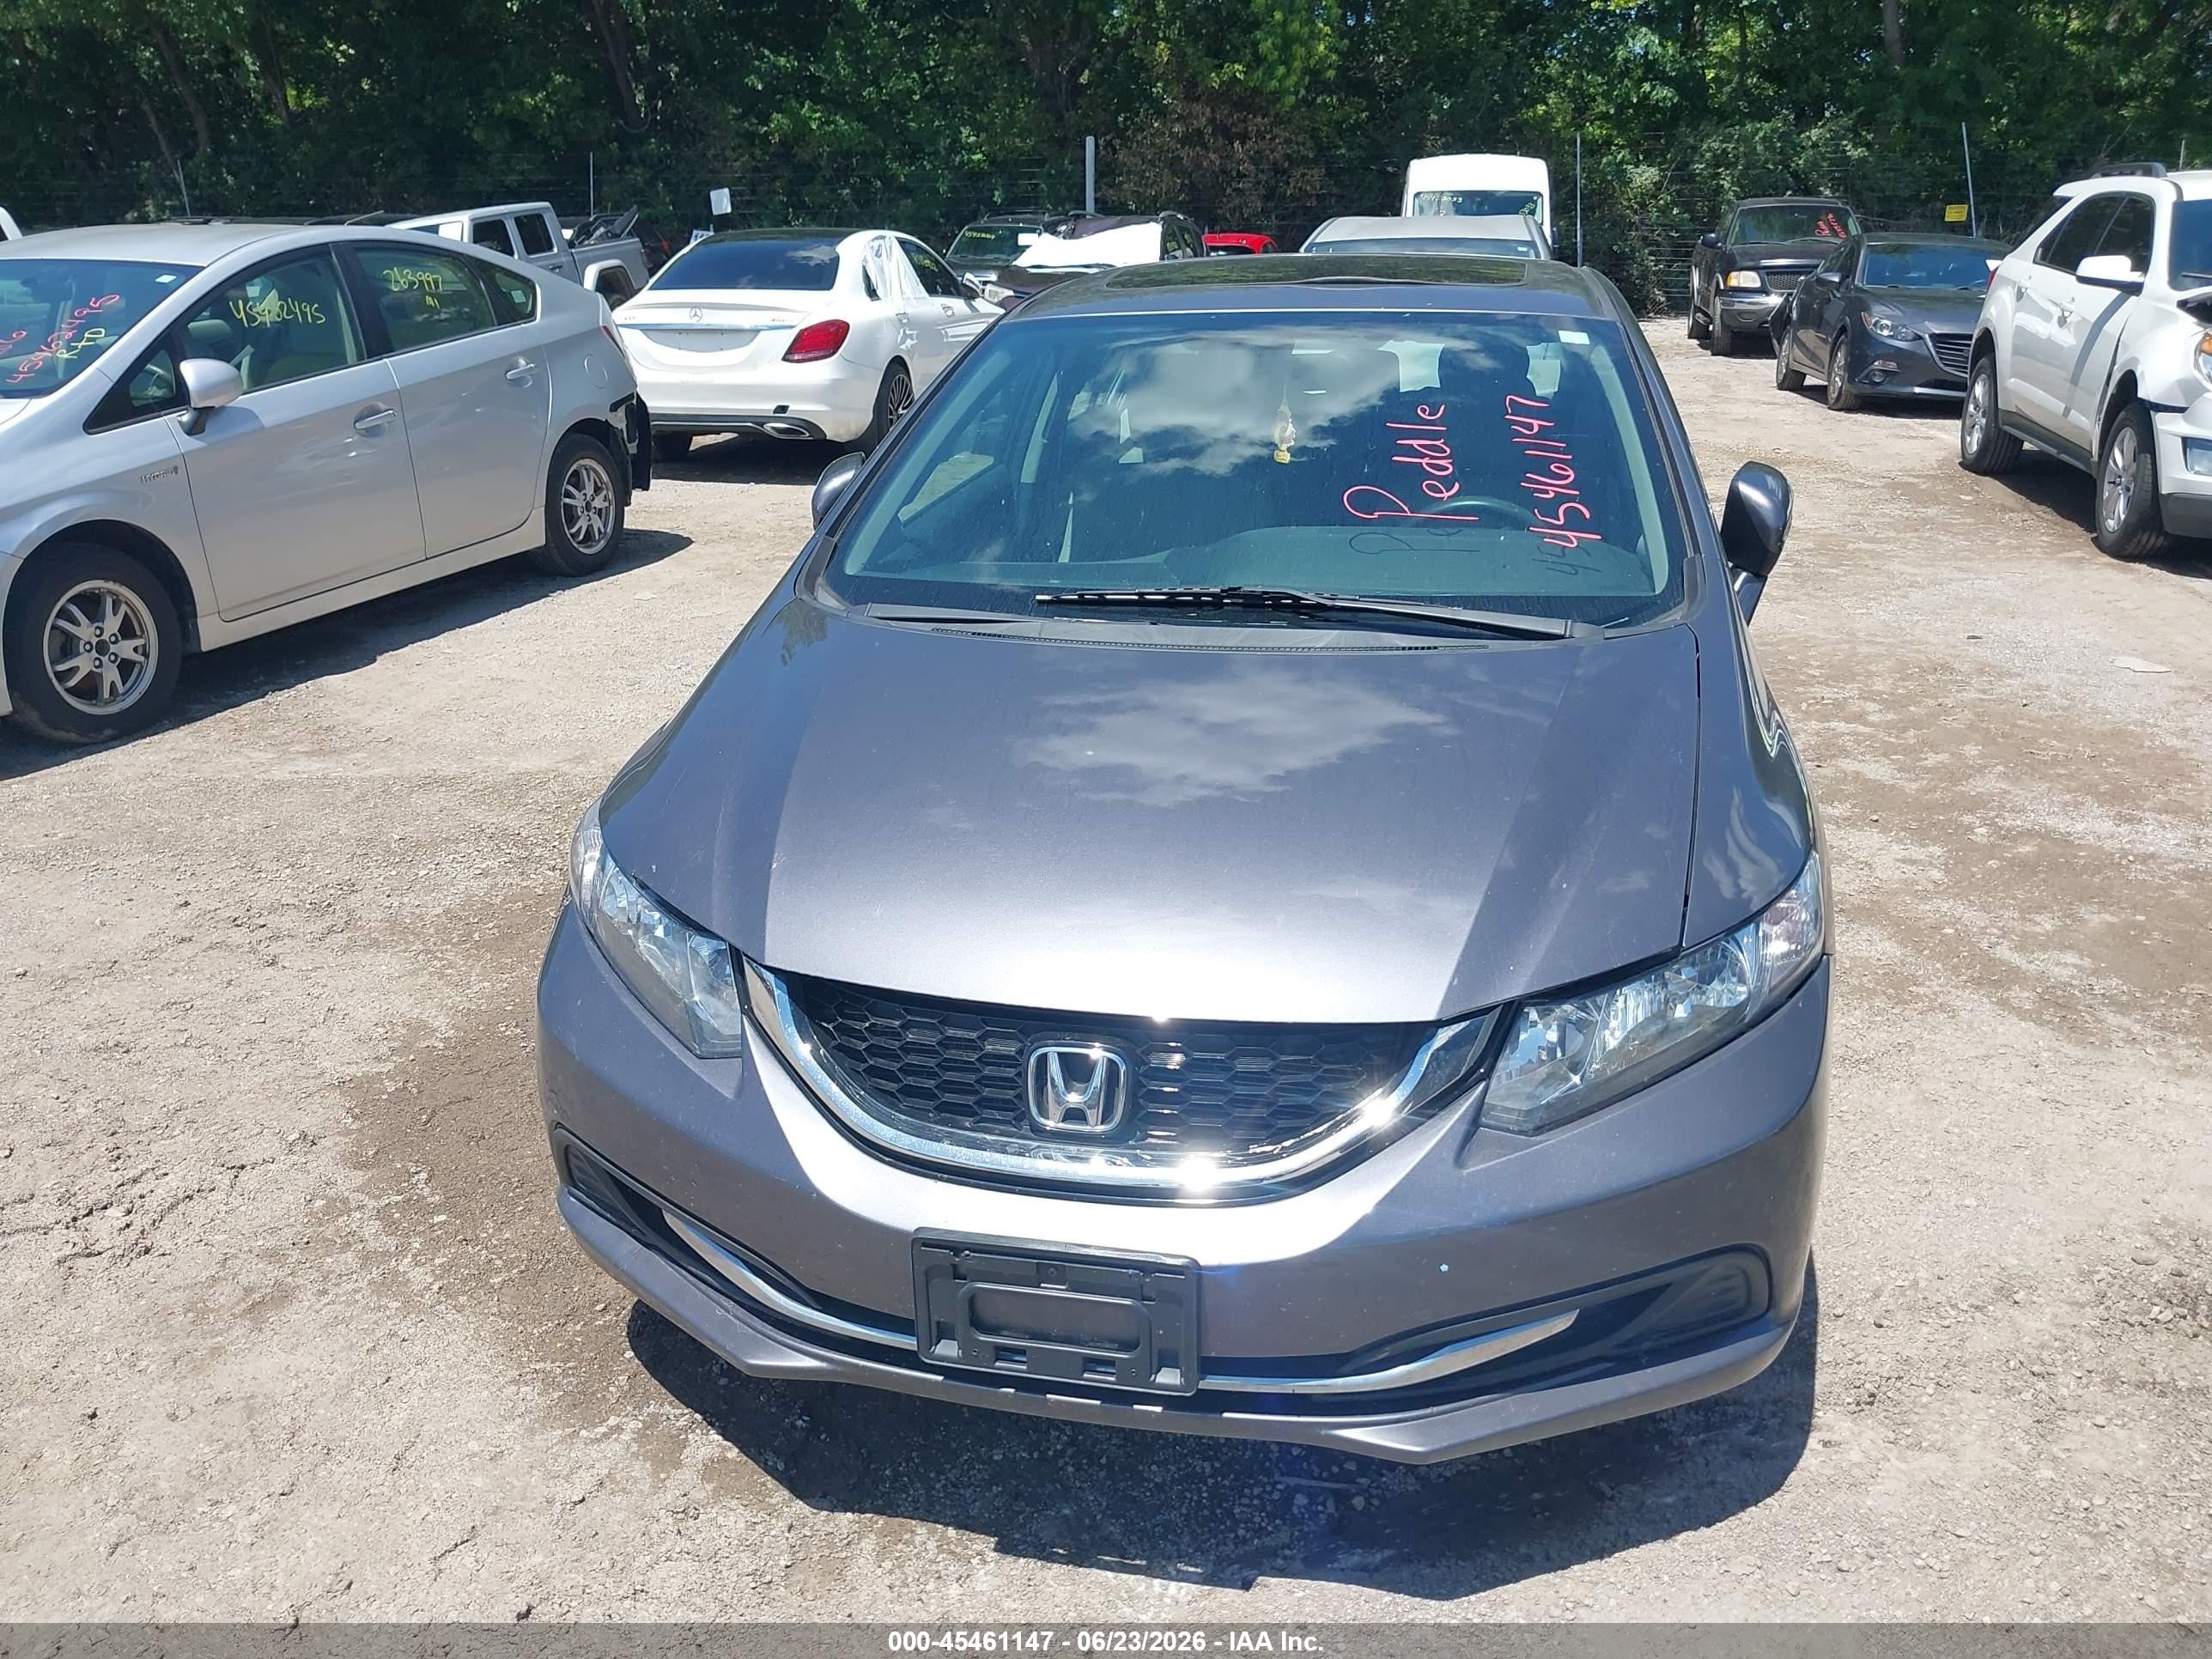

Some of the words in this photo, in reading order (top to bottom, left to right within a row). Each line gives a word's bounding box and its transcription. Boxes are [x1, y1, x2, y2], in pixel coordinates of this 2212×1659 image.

[383, 266, 443, 293] 263997
[5, 294, 120, 383] 45462495
[1342, 404, 1480, 520] Peddle
[1504, 394, 1602, 548] 45461147
